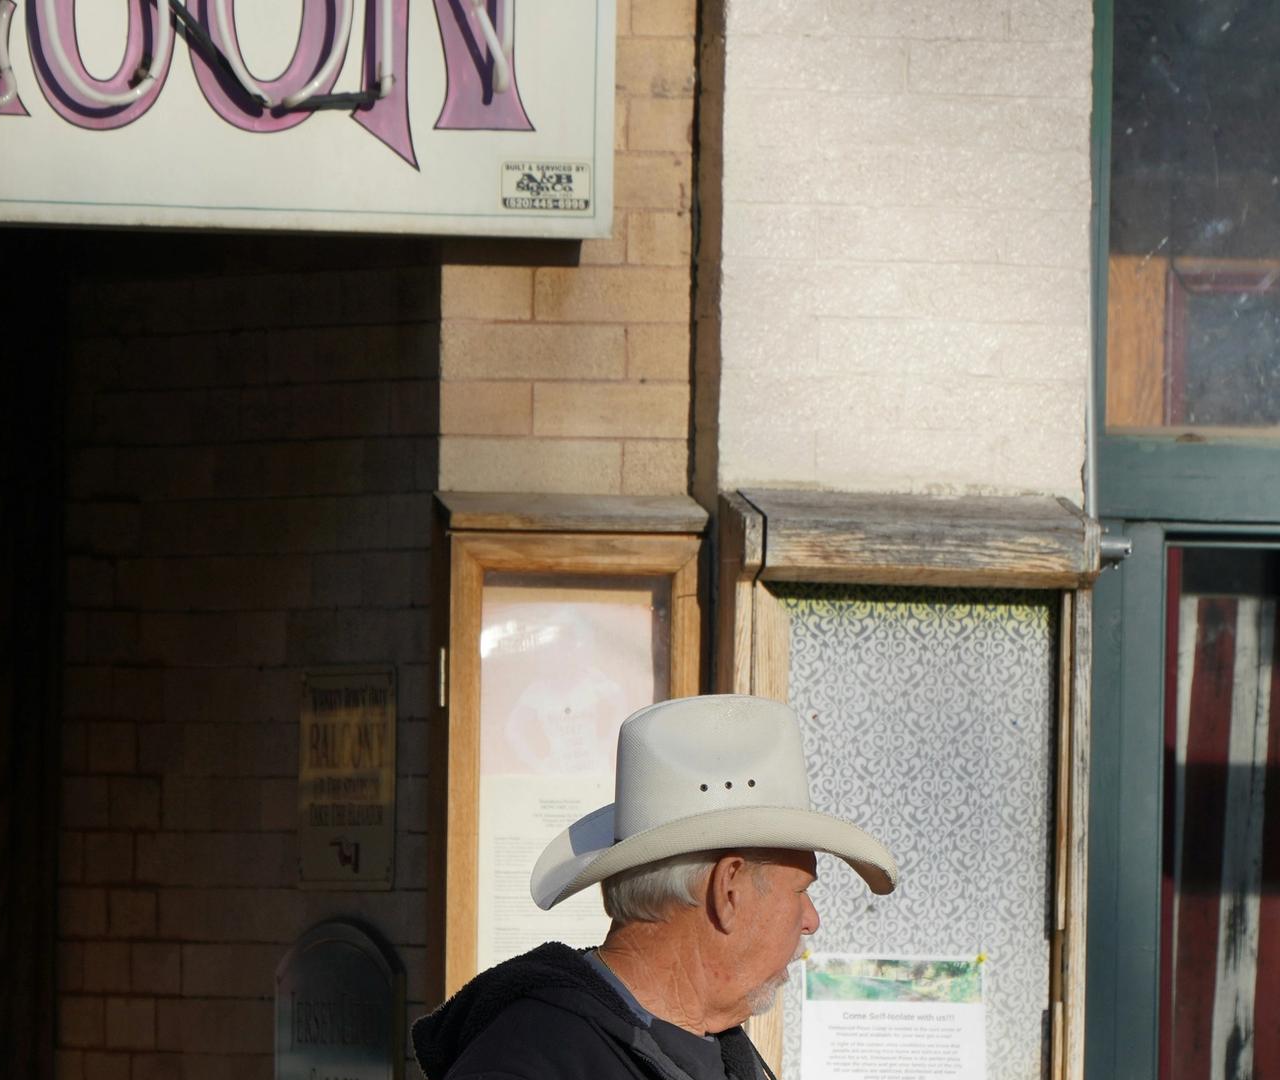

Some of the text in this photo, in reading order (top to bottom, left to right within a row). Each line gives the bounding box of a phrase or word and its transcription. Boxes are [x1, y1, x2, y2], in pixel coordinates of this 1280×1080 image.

[309, 722, 386, 769] BALCONY
[842, 1012, 867, 1020] Come
[917, 1013, 934, 1022] with
